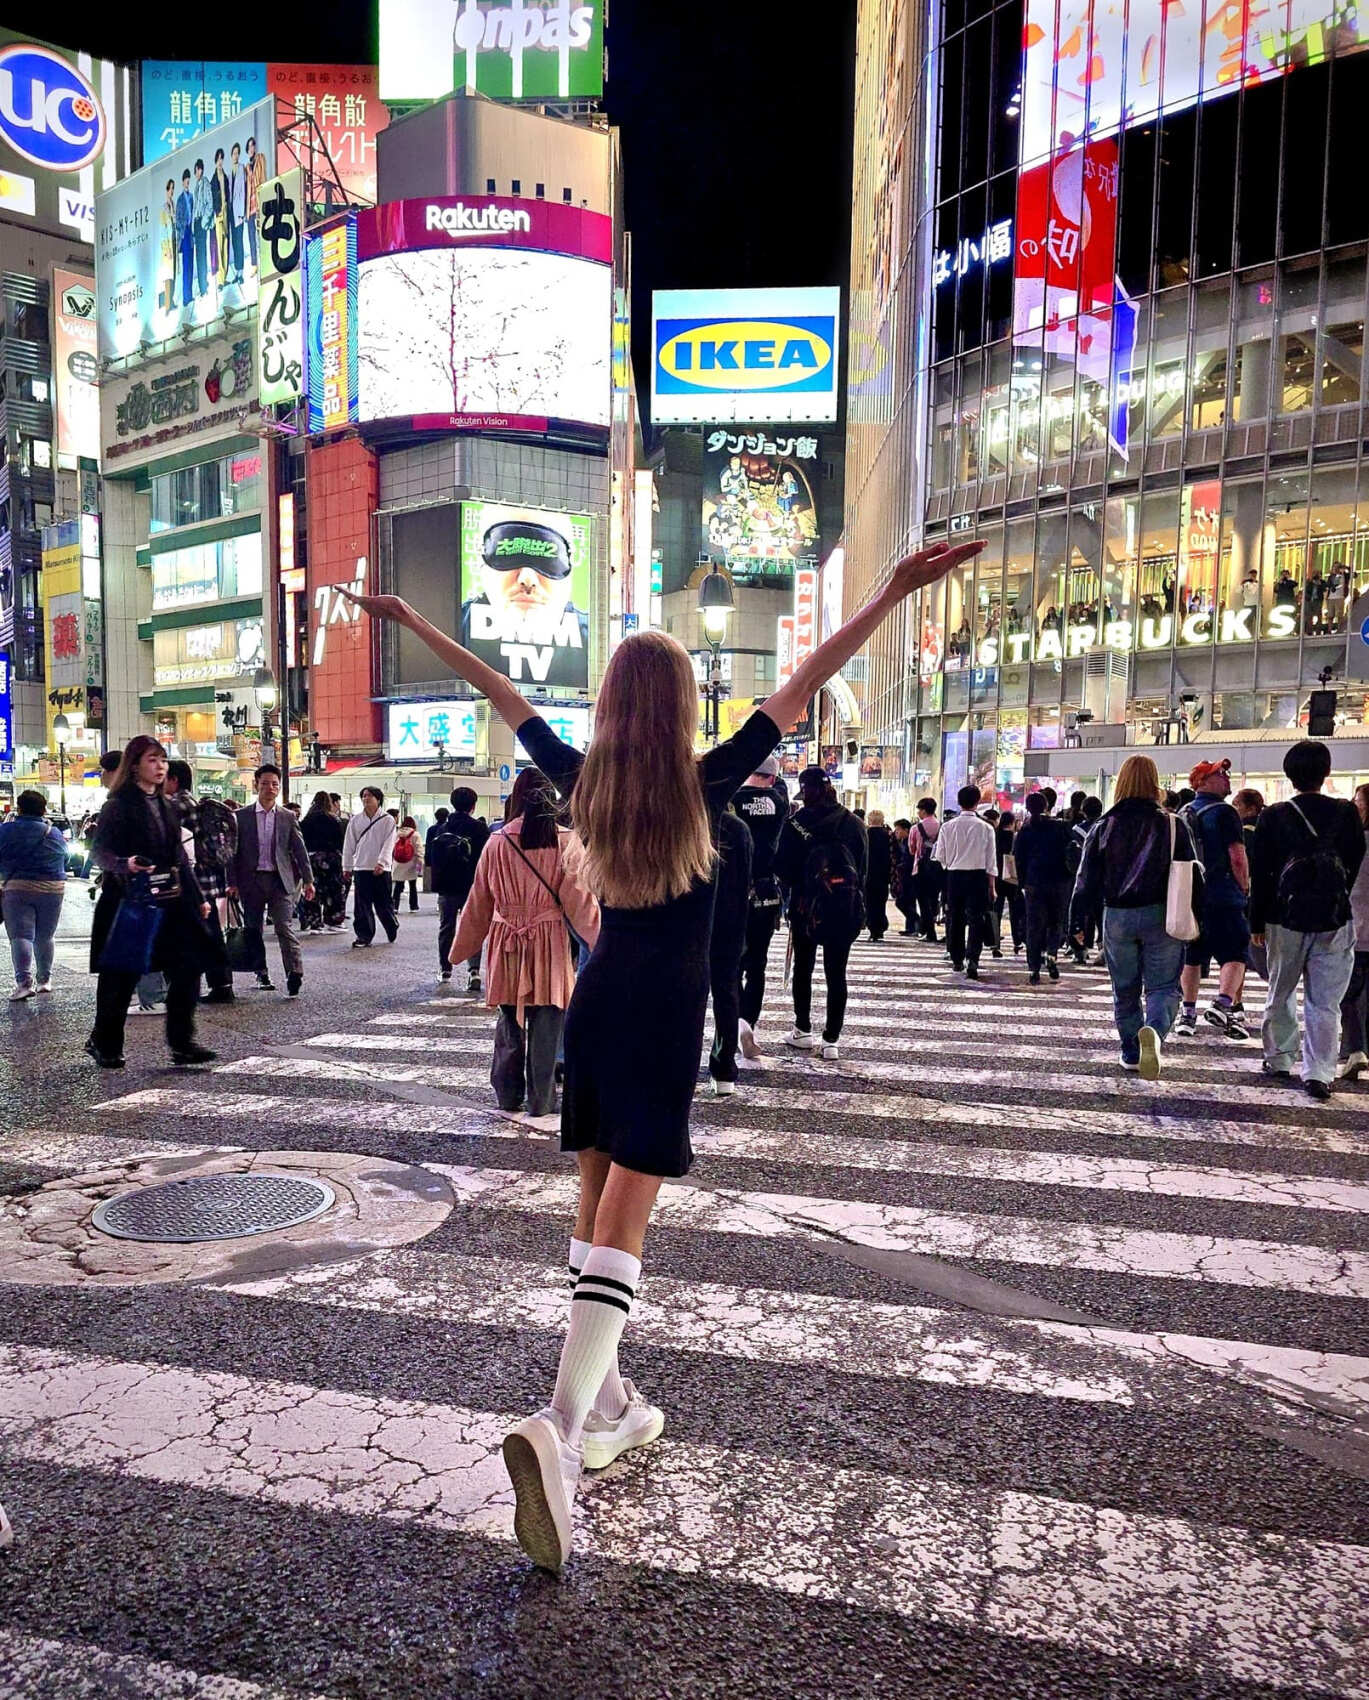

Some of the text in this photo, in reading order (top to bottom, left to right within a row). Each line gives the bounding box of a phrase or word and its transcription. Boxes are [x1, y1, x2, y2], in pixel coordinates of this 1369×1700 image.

[294, 93, 367, 127] 龍角散
[425, 202, 530, 238] Rakuten
[109, 285, 144, 311] Synopsis
[261, 181, 302, 391] もんじゃ
[321, 235, 341, 414] 三千里薬品
[675, 340, 819, 370] IKEA
[449, 416, 508, 426] Rakuten Vision
[706, 430, 818, 460] ダンジョン飯
[470, 603, 583, 648] DMM
[977, 604, 1297, 666] STARBUCKS
[500, 643, 554, 682] TV
[742, 803, 768, 811] NORTH
